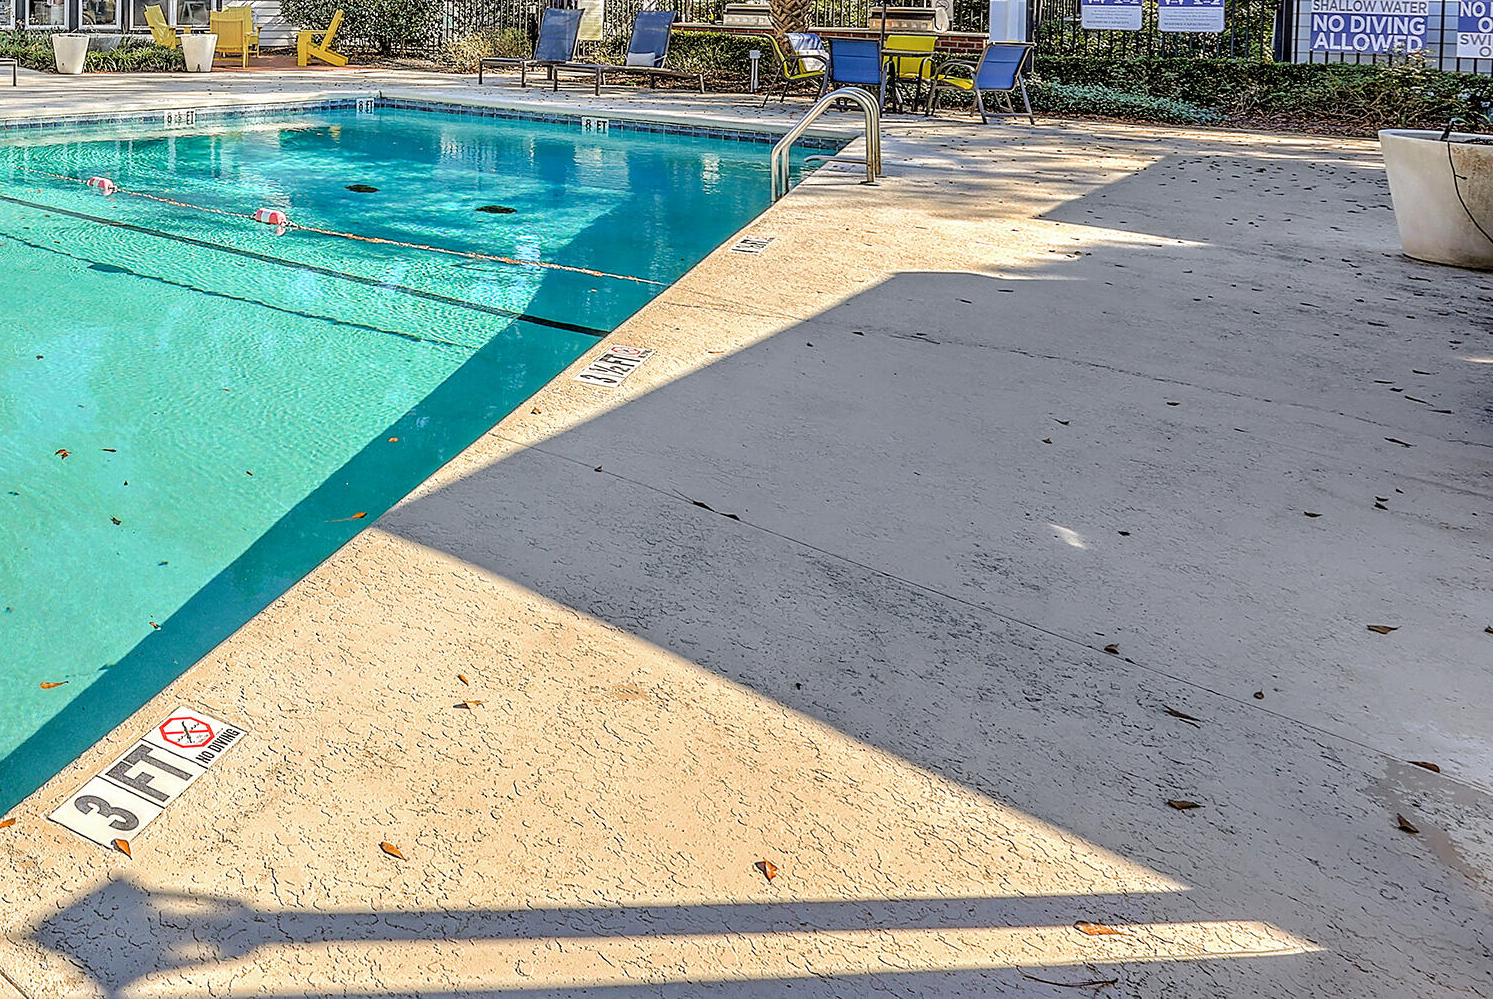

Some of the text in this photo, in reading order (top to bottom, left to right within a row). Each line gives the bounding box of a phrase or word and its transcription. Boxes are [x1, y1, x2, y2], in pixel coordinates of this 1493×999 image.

[1313, 0, 1427, 14] SHALLOW WATER
[1460, 1, 1486, 18] NO
[1313, 15, 1426, 35] NO DIVING
[1313, 32, 1423, 52] ALLOWED
[596, 120, 607, 133] FT
[580, 374, 618, 384] 3
[599, 353, 641, 368] FT
[195, 728, 242, 764] NO DIVING
[74, 743, 194, 832] 3 FT
